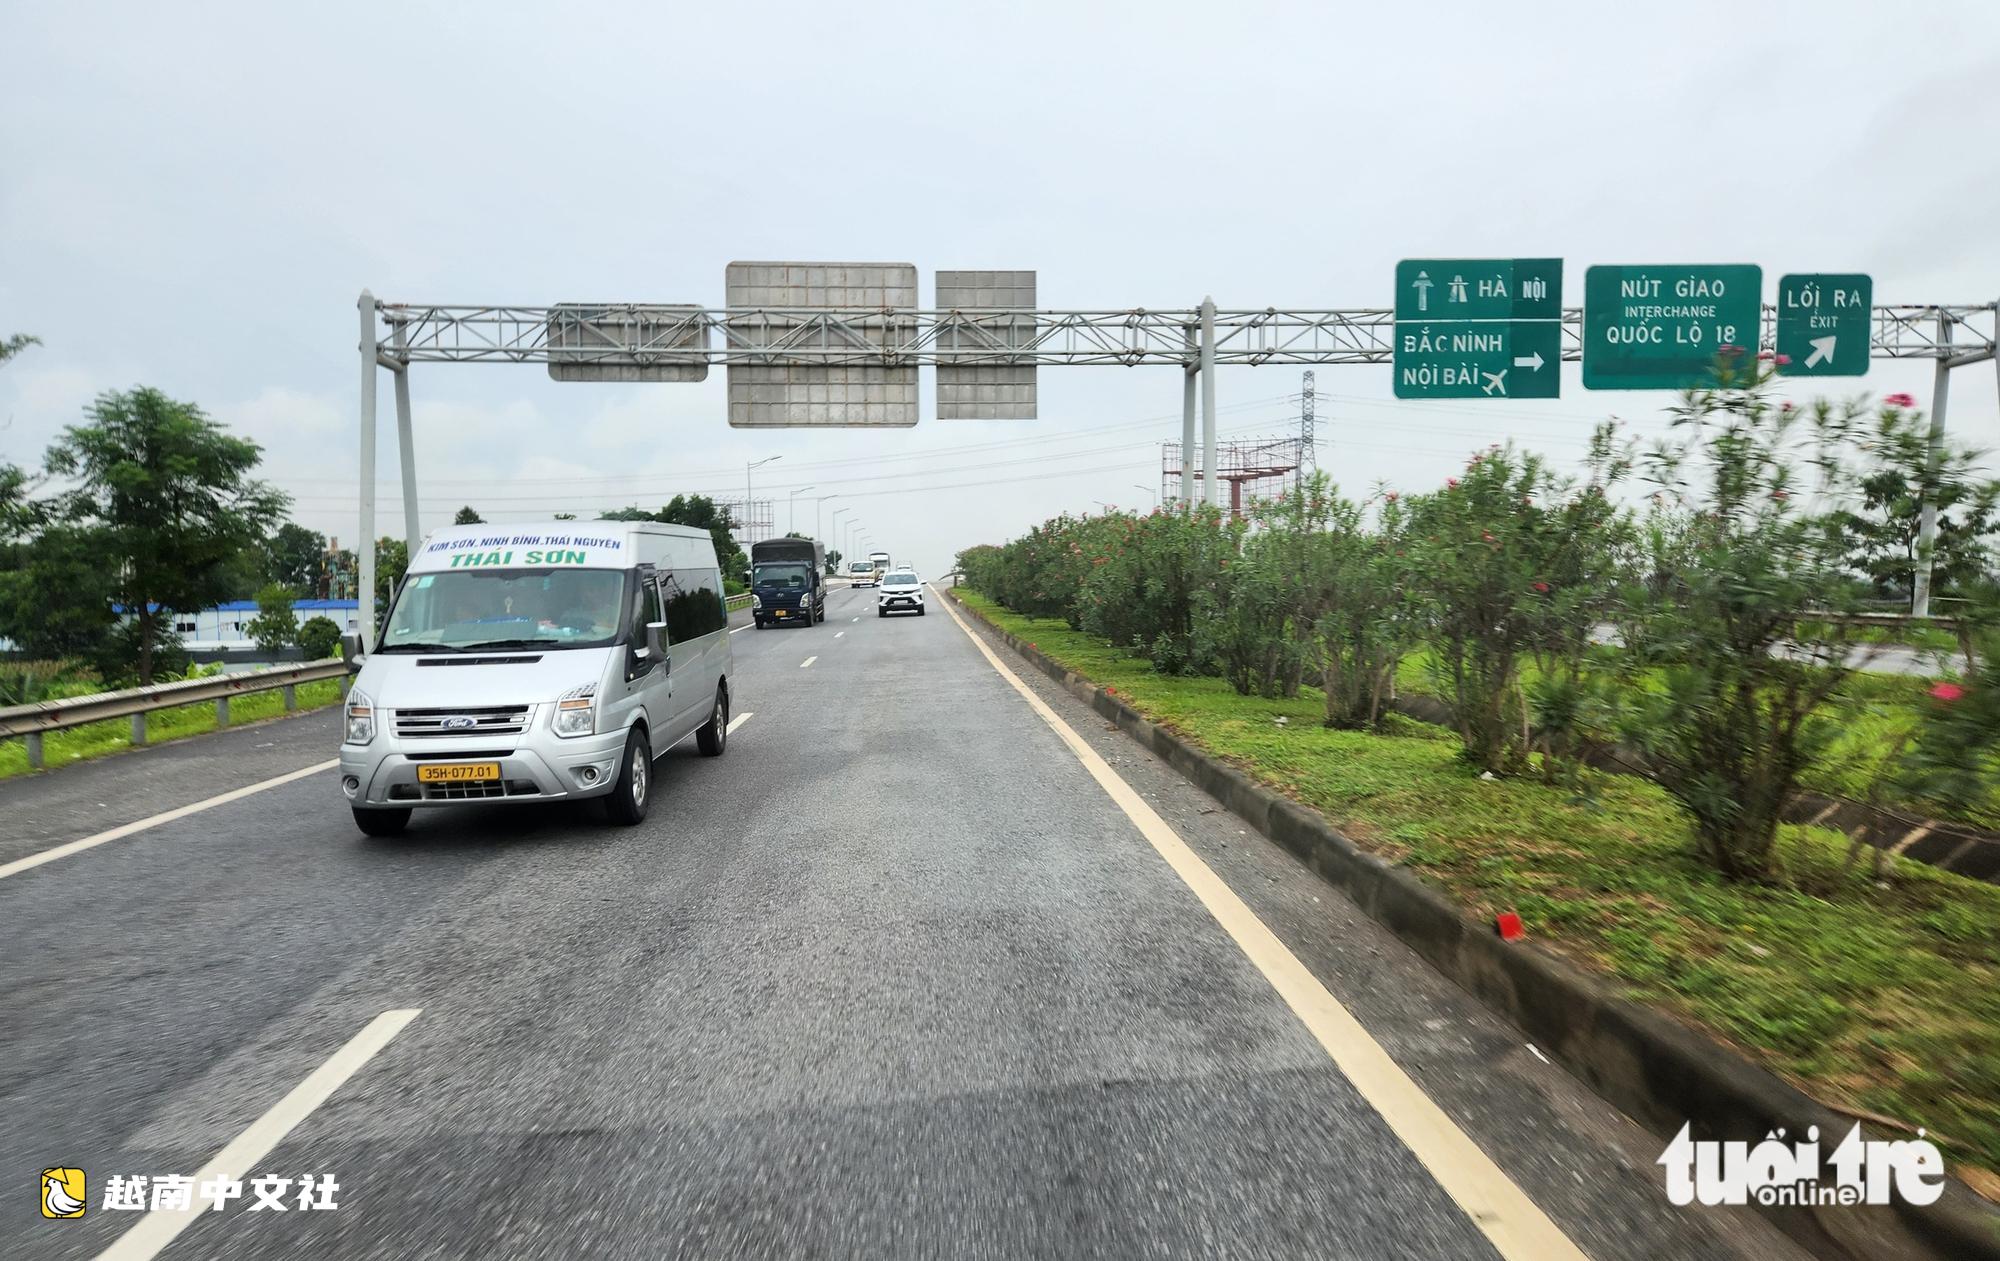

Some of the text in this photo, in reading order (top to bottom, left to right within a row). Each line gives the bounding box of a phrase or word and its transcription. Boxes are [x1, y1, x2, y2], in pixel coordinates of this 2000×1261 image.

[1478, 274, 1547, 302] HÀ NỘI
[1621, 275, 1661, 298] NÚT
[1834, 289, 1863, 308] RA
[1624, 305, 1717, 318] INTERCHANGE
[1810, 315, 1838, 329] EXIT
[1404, 326, 1448, 353] BẮC
[1606, 319, 1737, 348] QUỐC LỘ 18
[427, 541, 449, 553] KIM
[481, 536, 508, 548] NINH
[451, 547, 587, 568] THÁI SƠN
[448, 718, 468, 728] Ford
[425, 766, 491, 779] 35H-077.01
